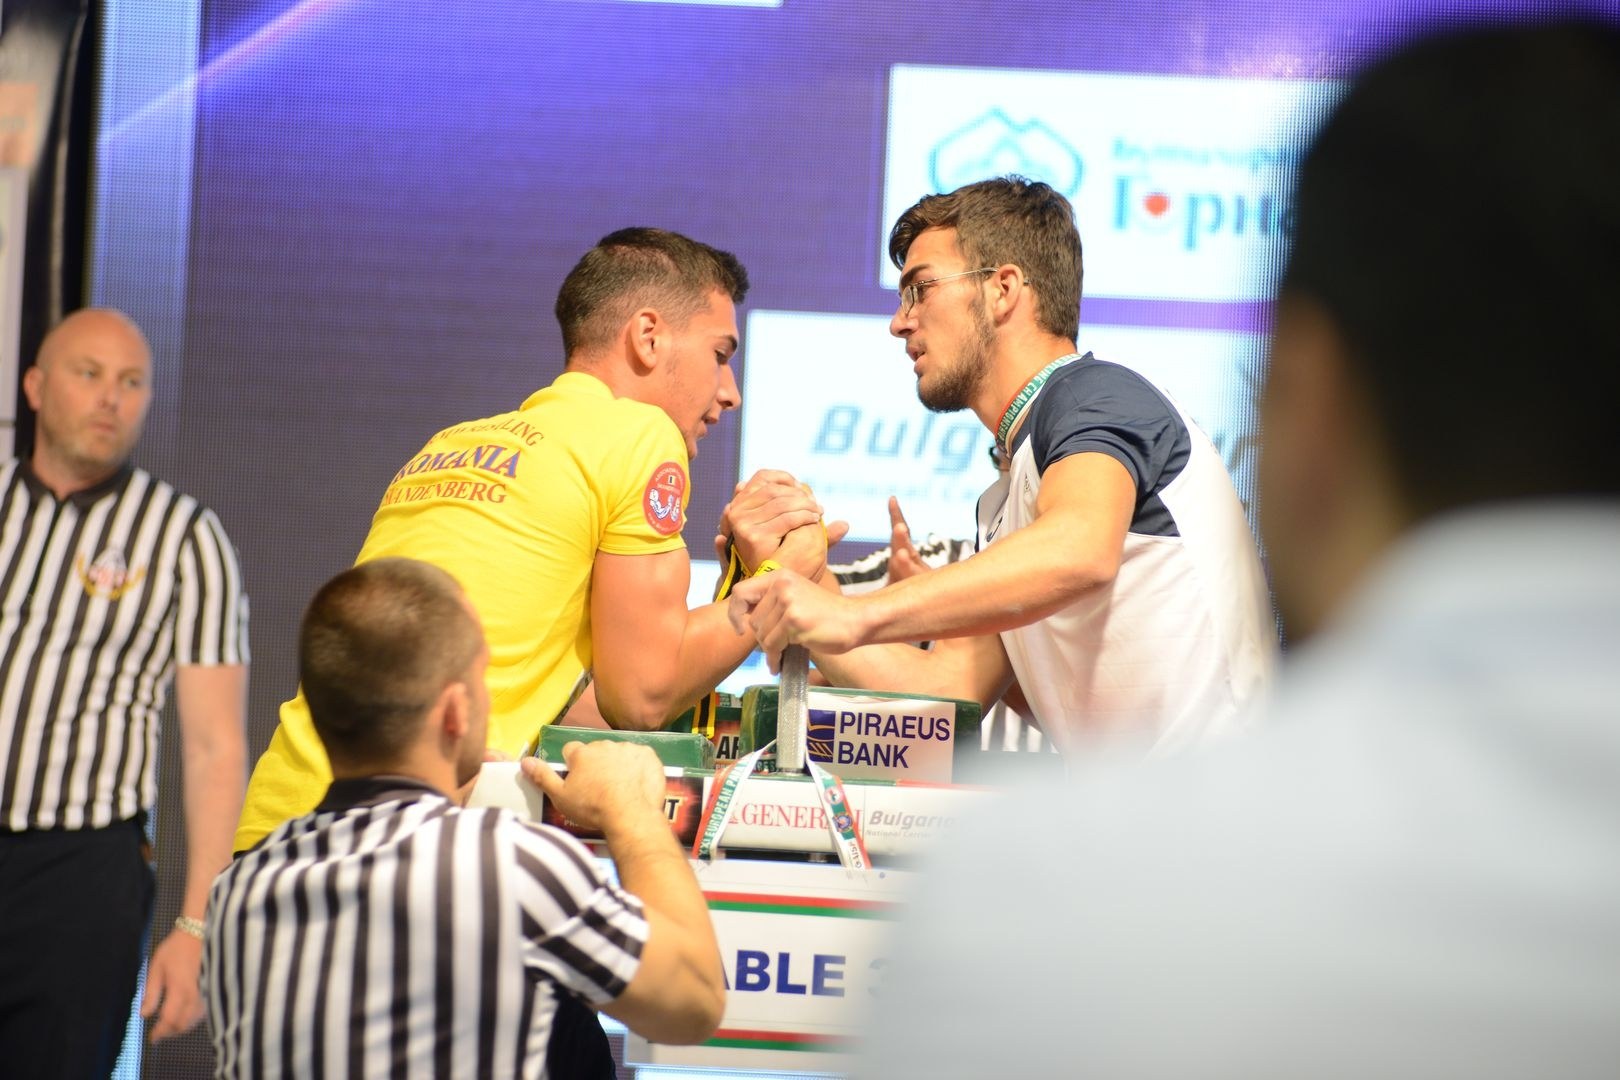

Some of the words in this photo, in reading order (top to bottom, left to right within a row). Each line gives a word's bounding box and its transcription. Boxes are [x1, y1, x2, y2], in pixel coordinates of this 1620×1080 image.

[812, 403, 981, 475] Bulg
[839, 711, 951, 742] PIRAEUS
[838, 740, 910, 768] BANK
[704, 786, 737, 839] EUROPEAN
[741, 802, 864, 832] GENERI
[722, 949, 847, 998] BLE
